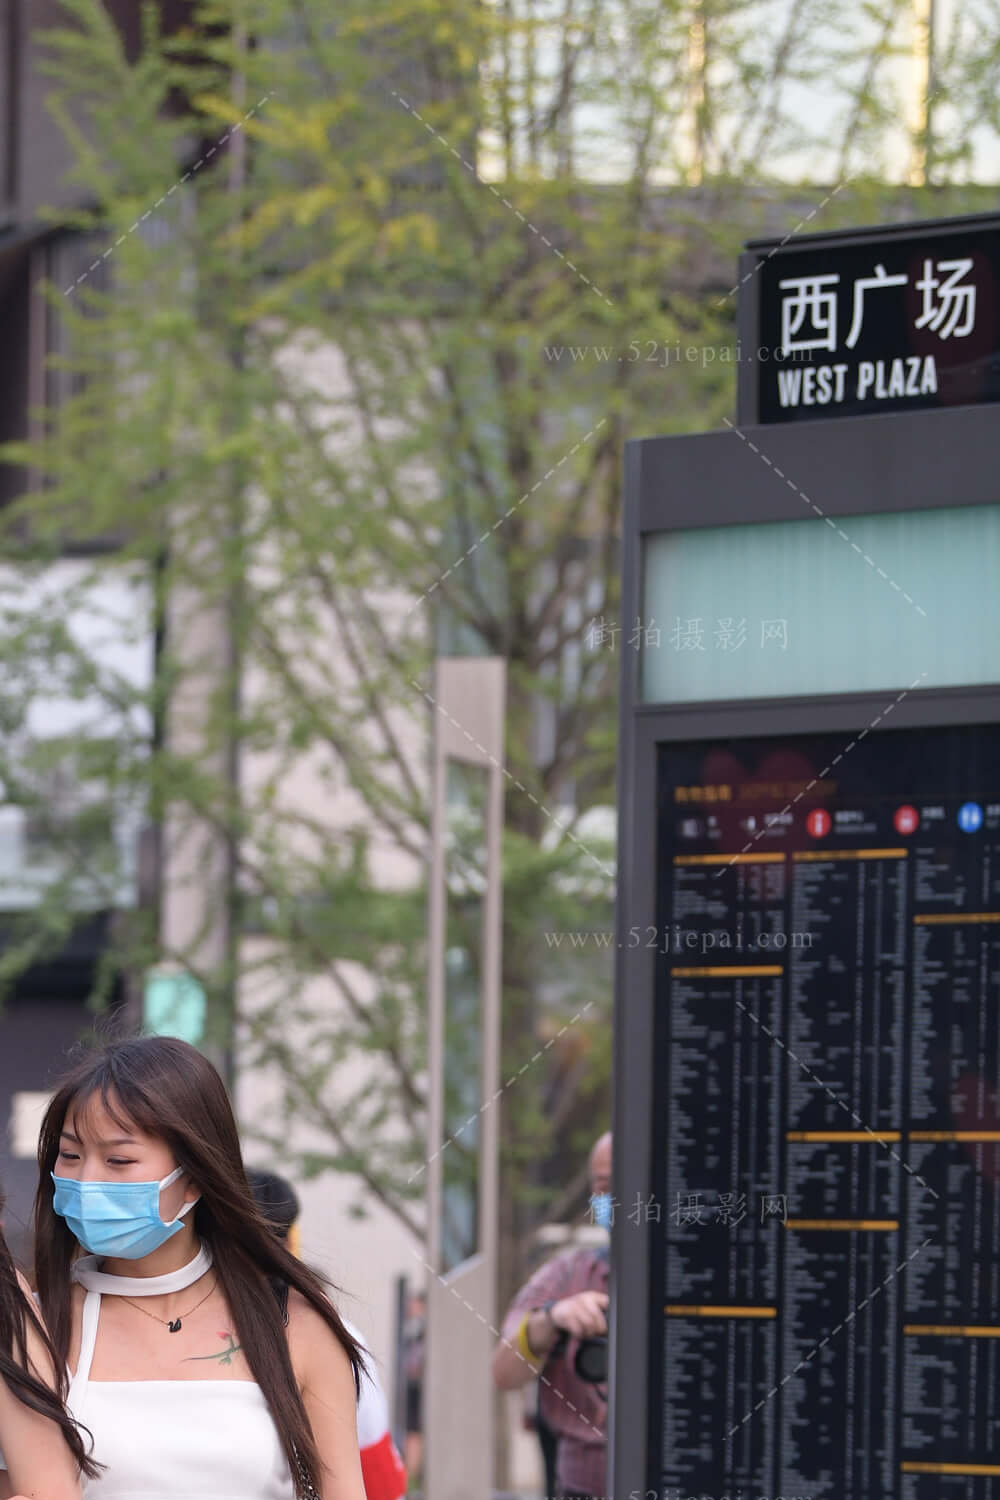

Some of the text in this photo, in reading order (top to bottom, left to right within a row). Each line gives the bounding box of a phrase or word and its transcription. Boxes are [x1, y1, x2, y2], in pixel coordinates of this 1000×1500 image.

[778, 257, 977, 357] 西广场
[778, 355, 938, 408] WEST PLAZA
